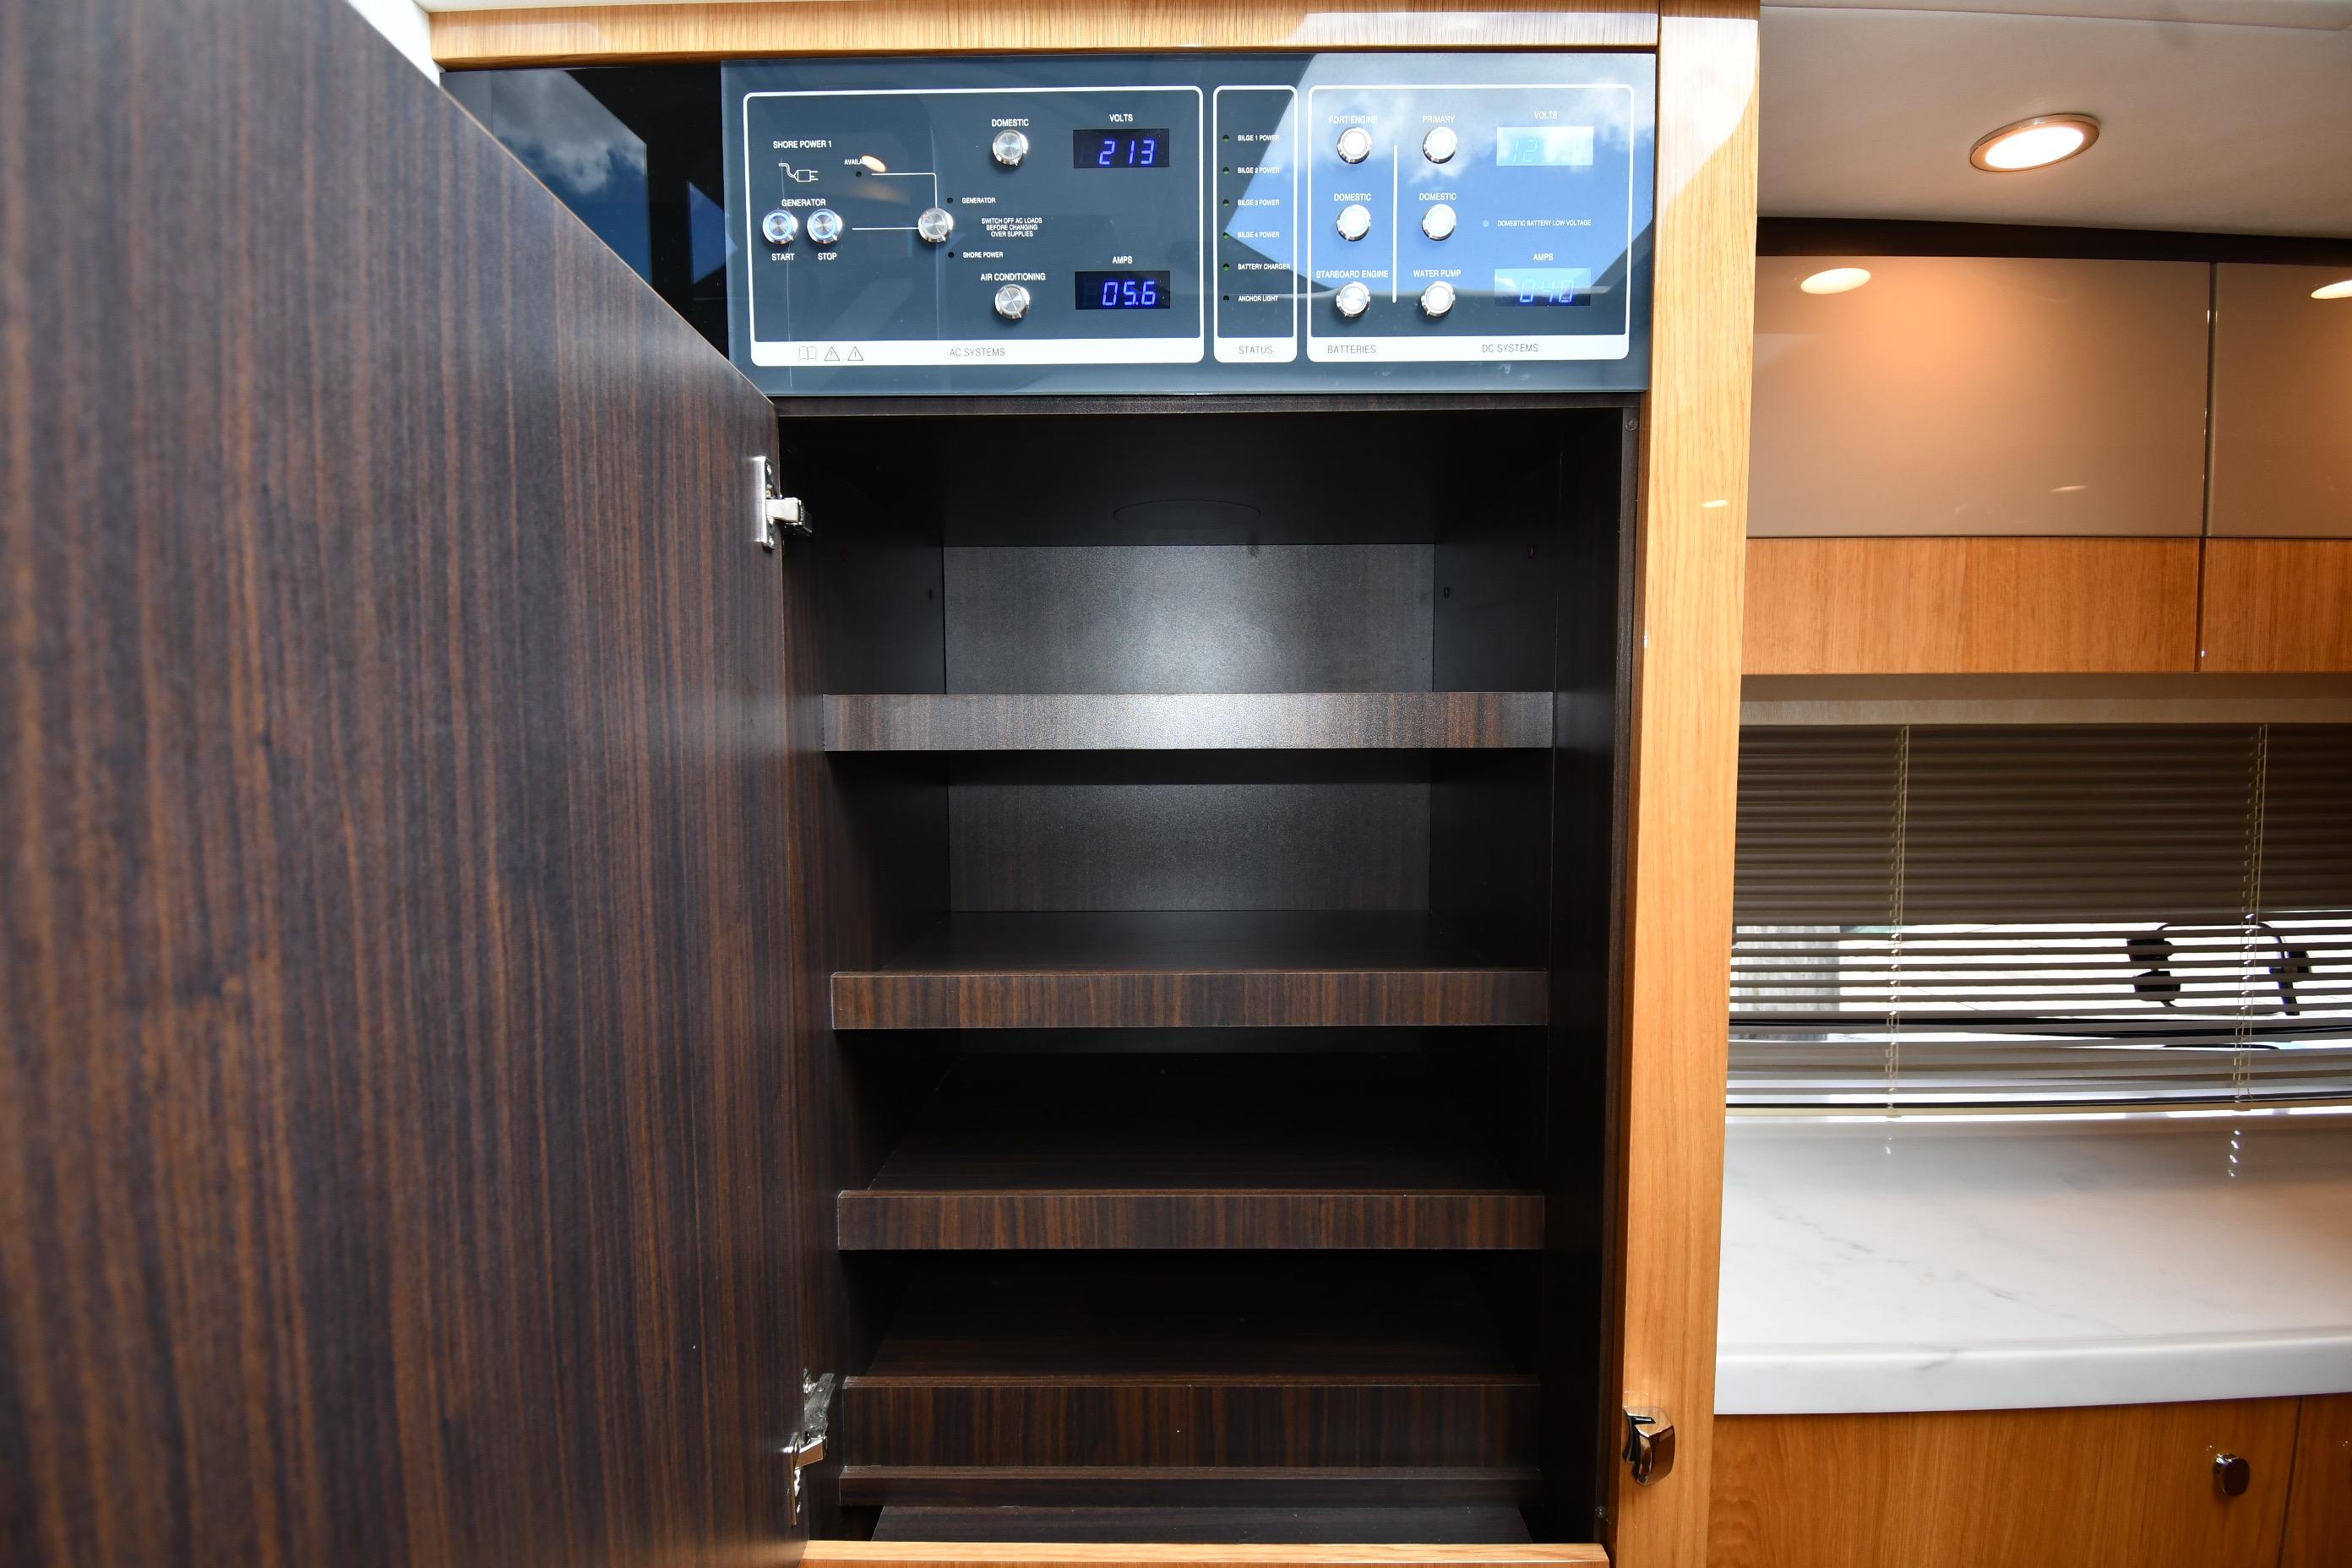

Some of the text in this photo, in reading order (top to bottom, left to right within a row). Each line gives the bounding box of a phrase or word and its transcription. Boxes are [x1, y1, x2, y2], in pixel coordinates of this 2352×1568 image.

[1109, 113, 1134, 122] VOLTS
[1423, 115, 1455, 123] PRIMARY
[1534, 111, 1559, 119] VOLTS
[991, 118, 1029, 127] DOMESTIC
[773, 140, 798, 149] SHORE
[1099, 139, 1155, 165] 213
[1334, 193, 1372, 201] DOMESTIC
[1418, 193, 1456, 201] DOMESTIC
[781, 199, 826, 207] GENERATOR
[771, 253, 795, 261] START
[818, 253, 837, 261] STOP
[1112, 256, 1133, 264] AMPS
[1533, 253, 1554, 261] AMPS
[980, 272, 1046, 281] AIR CONDITIONING
[1315, 270, 1389, 278] STARBOARD ENGINE
[1413, 270, 1440, 278] WATER
[1102, 280, 1156, 306] 05.6
[950, 348, 1005, 357] AC SYSTEMS
[1239, 346, 1273, 355] STATUS
[1327, 346, 1376, 354] BATTERIES
[1482, 344, 1538, 353] DC SYSTEMS
